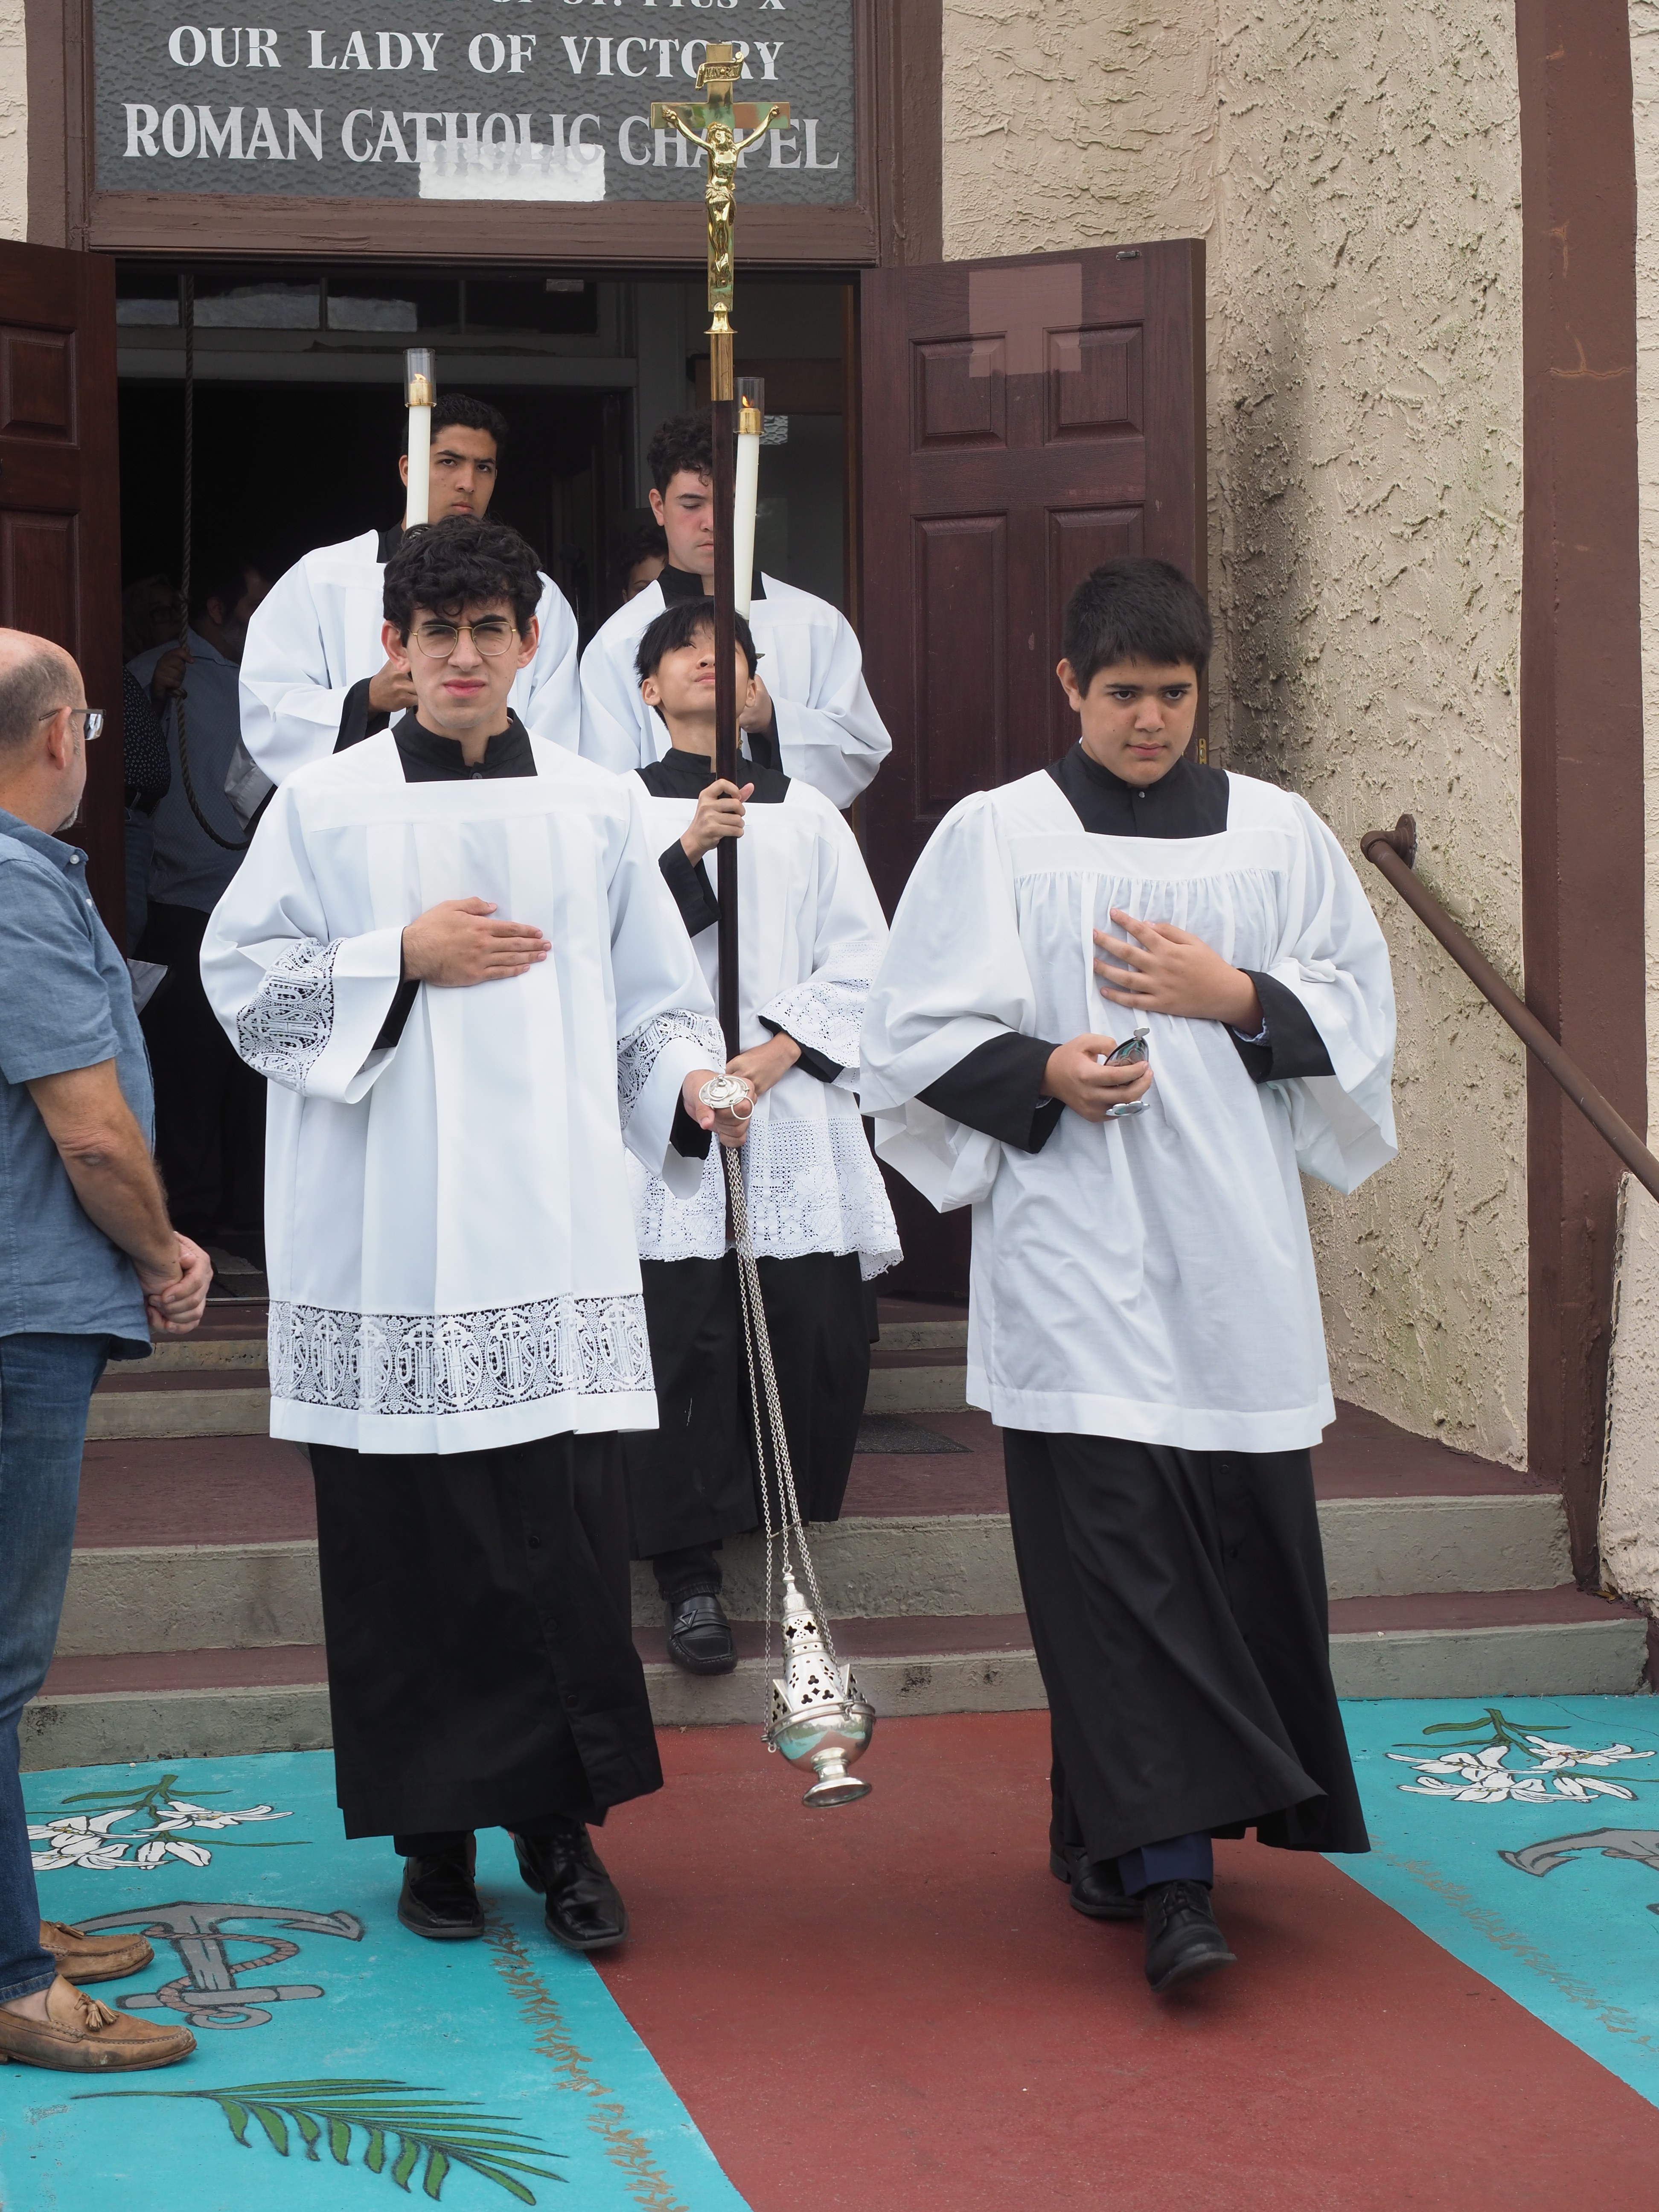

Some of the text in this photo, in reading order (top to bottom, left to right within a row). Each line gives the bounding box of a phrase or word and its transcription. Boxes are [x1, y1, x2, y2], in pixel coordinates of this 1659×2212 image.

[169, 26, 282, 67] OUR
[307, 30, 444, 71] LADY
[469, 33, 536, 73] OF
[121, 103, 323, 161] ROMAN
[341, 107, 601, 165] CATHOLIC
